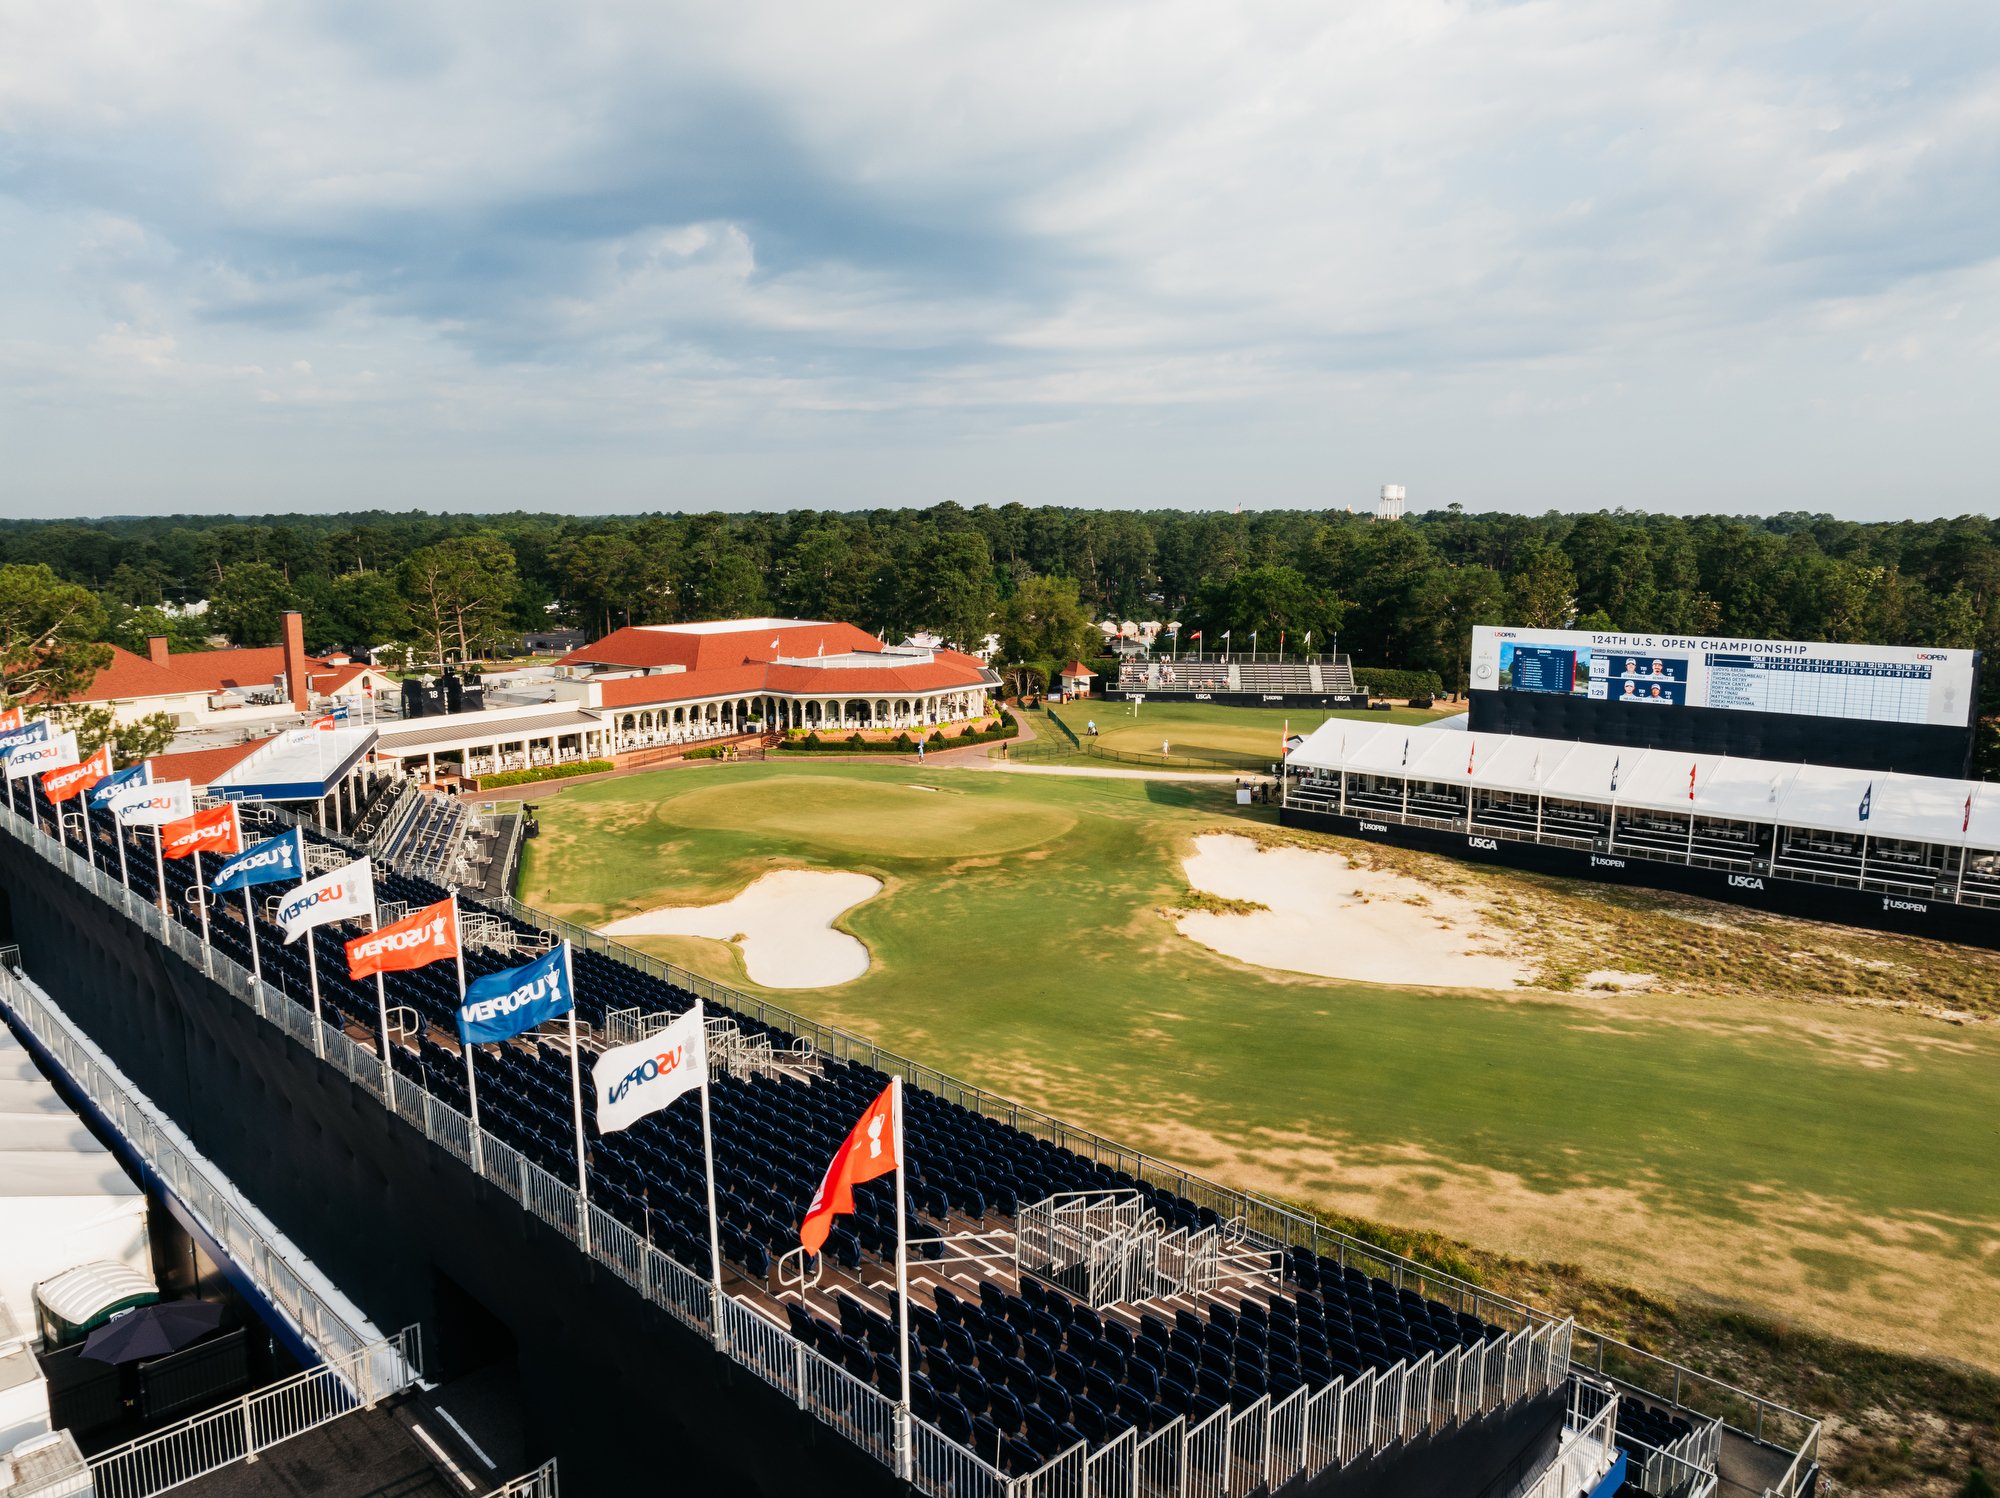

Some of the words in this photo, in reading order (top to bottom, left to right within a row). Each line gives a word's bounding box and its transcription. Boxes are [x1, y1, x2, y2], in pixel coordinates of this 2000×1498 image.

[1592, 636, 1626, 645] 124TH
[1632, 638, 1656, 646] U.S.
[1662, 639, 1696, 648] OPEN
[1701, 640, 1807, 654] CHAMPIONSHIP
[1364, 823, 1387, 832] USOPEN
[1468, 836, 1498, 850] USGA
[1596, 858, 1625, 868] USOPEN
[1728, 874, 1764, 890] USGA
[1890, 900, 1927, 912] USOPEN
